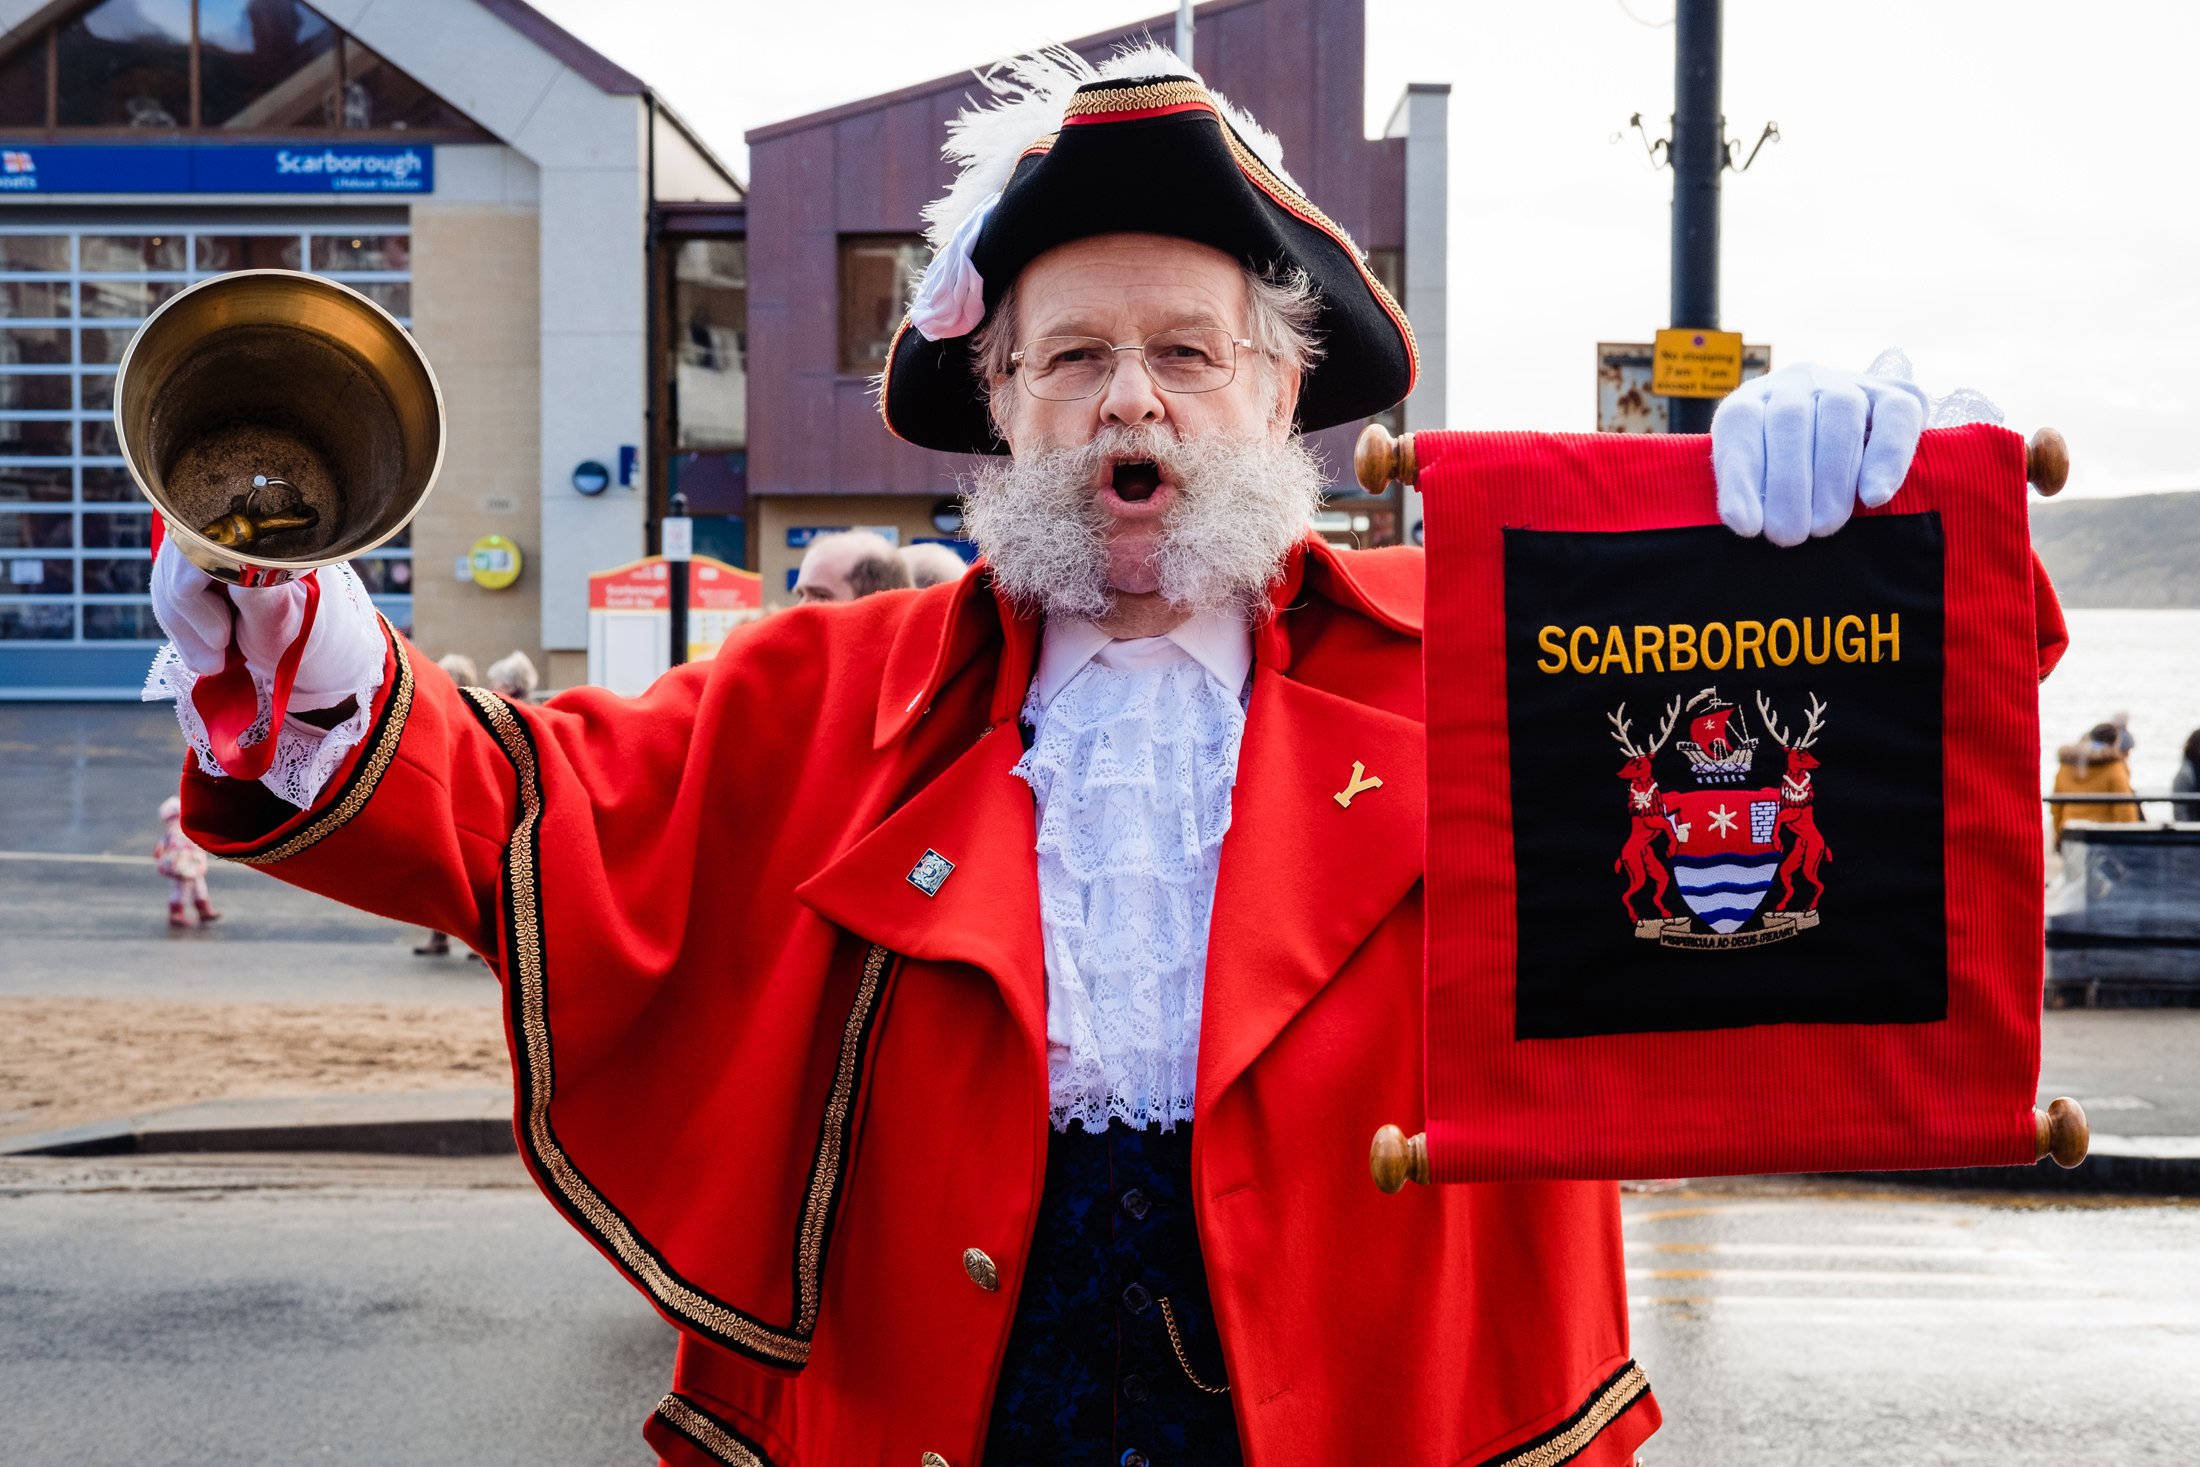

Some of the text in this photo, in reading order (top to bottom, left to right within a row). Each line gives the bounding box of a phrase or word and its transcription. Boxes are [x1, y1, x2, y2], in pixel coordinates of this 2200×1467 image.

[276, 150, 422, 179] Scarborough
[1661, 351, 1734, 364] No stopping
[1657, 382, 1697, 391] except
[1537, 613, 1900, 675] SCARBOROUGH
